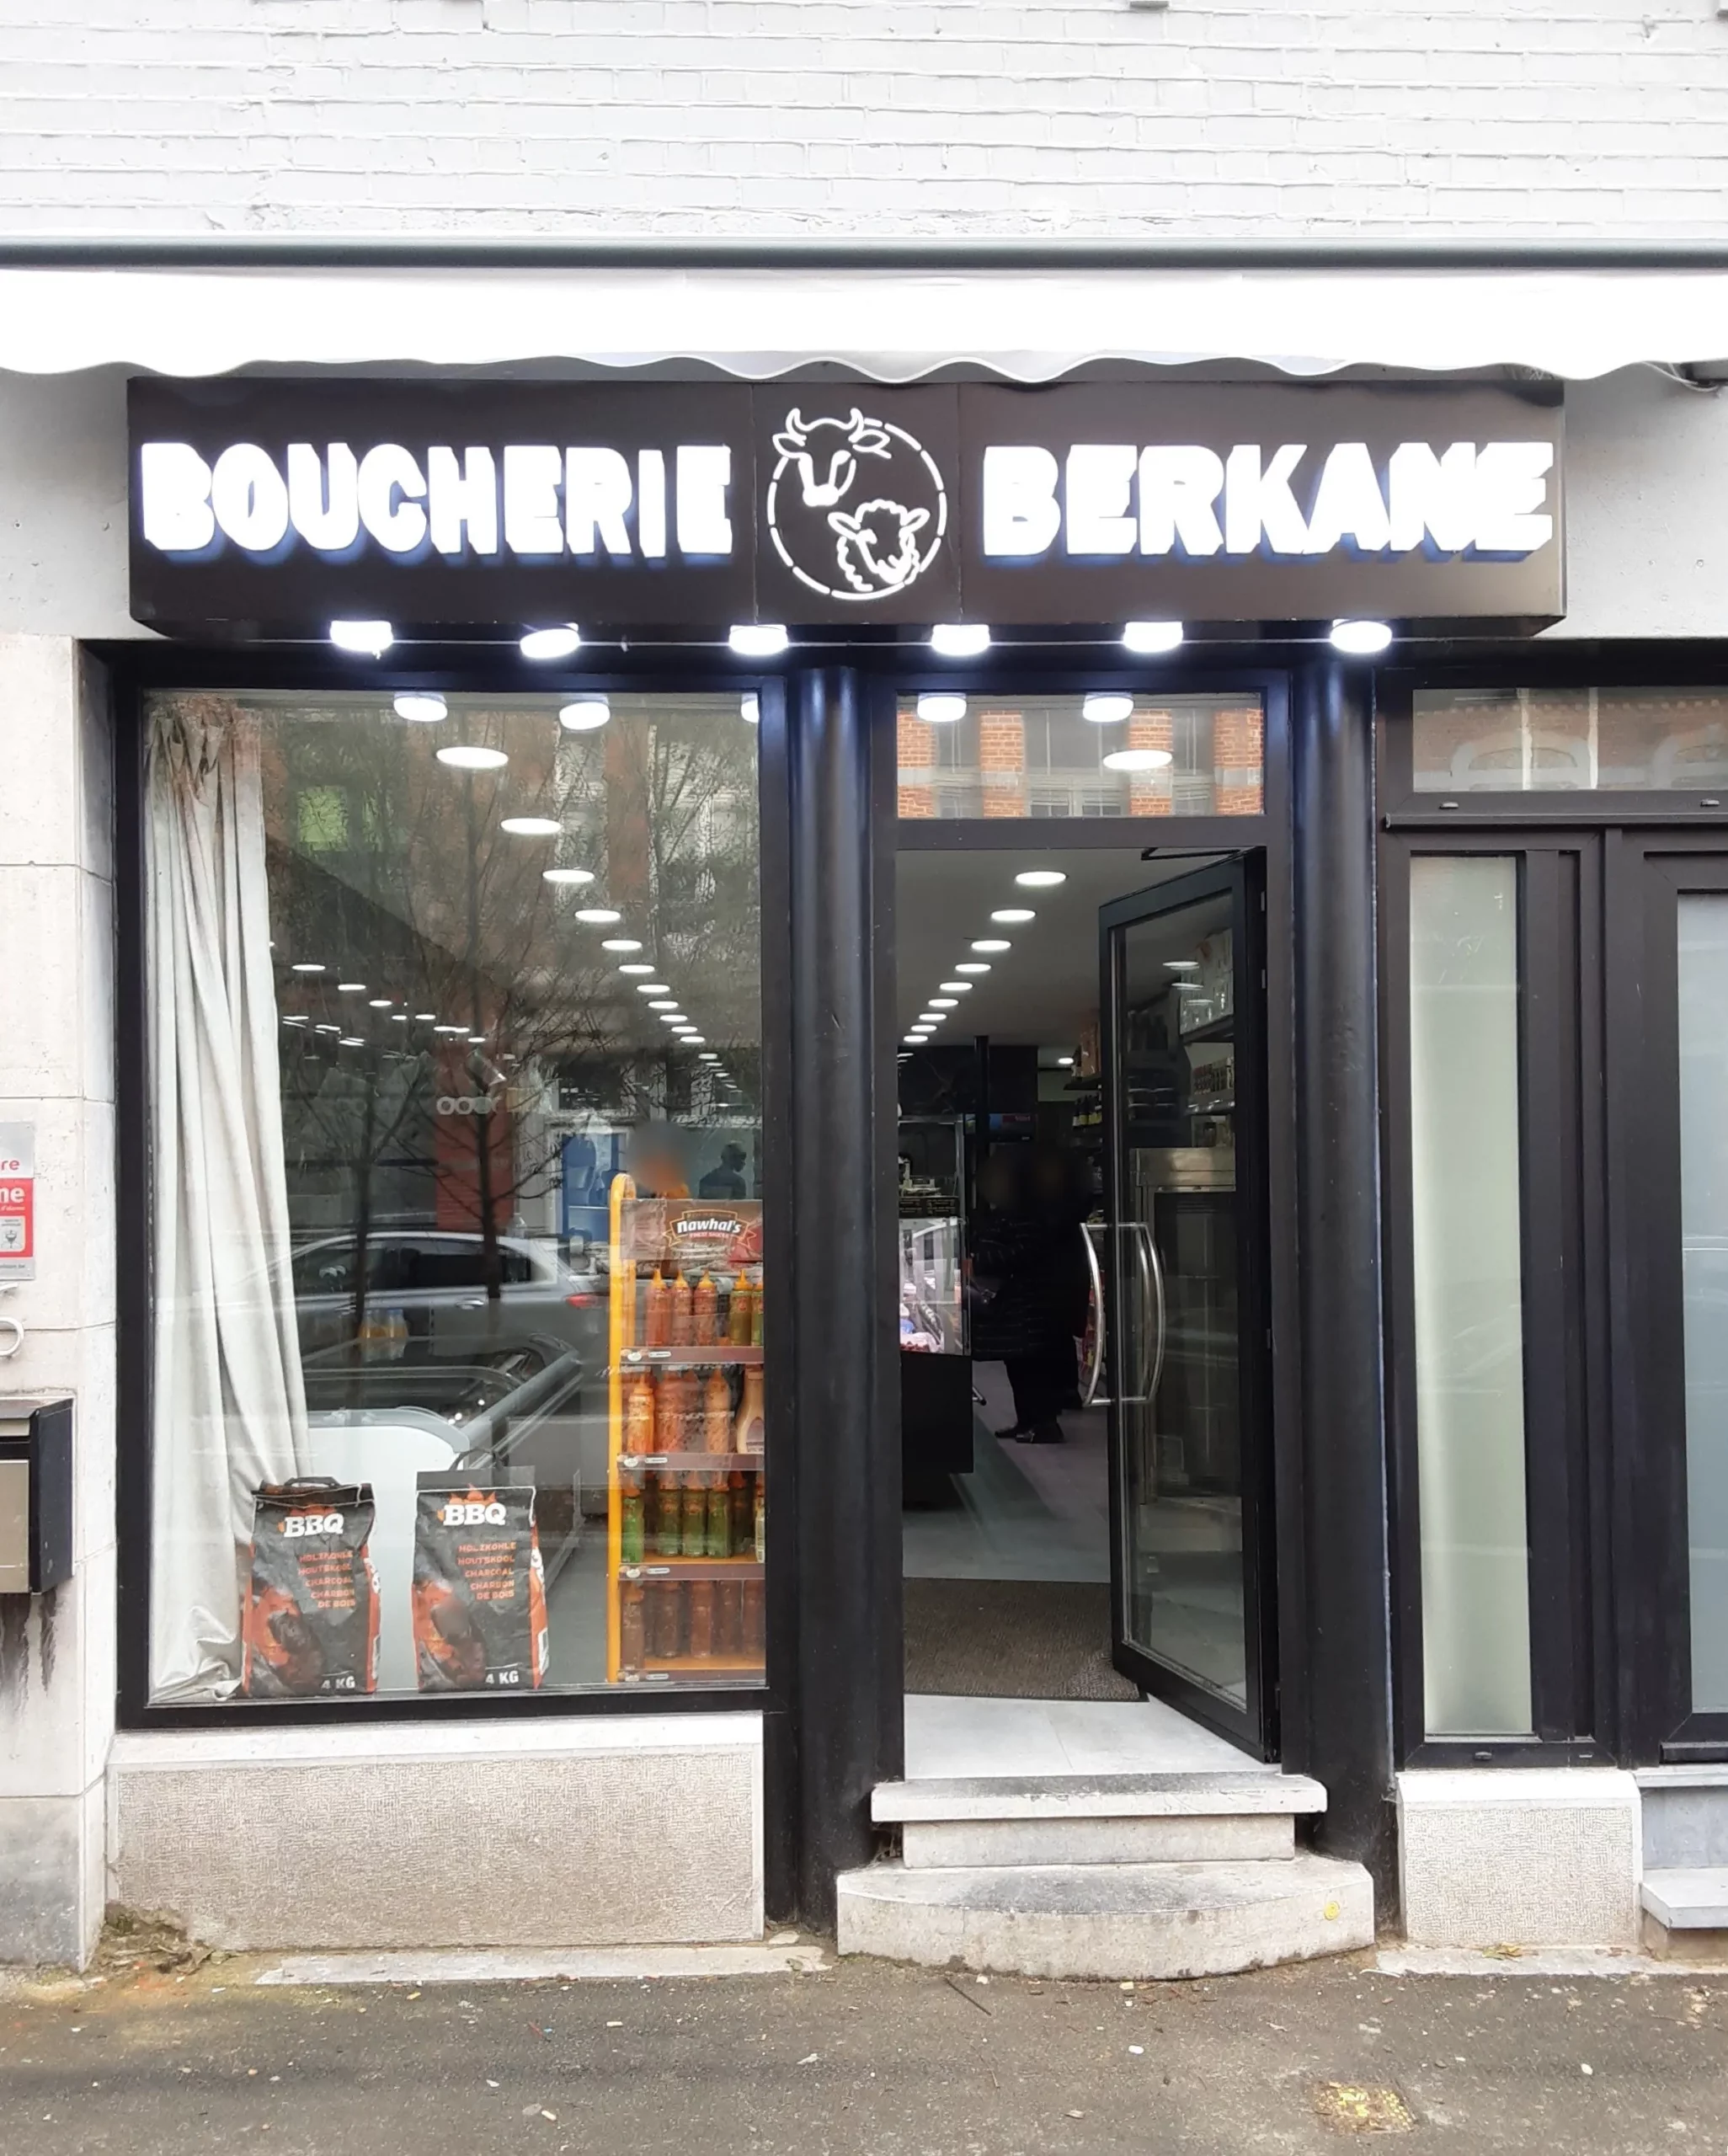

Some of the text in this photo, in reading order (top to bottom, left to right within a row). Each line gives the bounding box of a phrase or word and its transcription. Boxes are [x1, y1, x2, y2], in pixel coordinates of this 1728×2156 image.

[140, 441, 1555, 559] BOUCHERIE BERKANE
[443, 1502, 507, 1526] BBQ
[283, 1513, 344, 1538] BBQ
[458, 1541, 516, 1552] HOLZKOHLE
[457, 1555, 515, 1566] HOUTSKOOL
[465, 1568, 515, 1577] CHARCOAL
[305, 1577, 354, 1588] CHARCOAL
[470, 1580, 515, 1591] CHARBON
[477, 1590, 515, 1600] DE BOIS
[317, 1600, 330, 1609] DE
[322, 1676, 355, 1689] 4 KG
[485, 1670, 520, 1684] 4 KG
